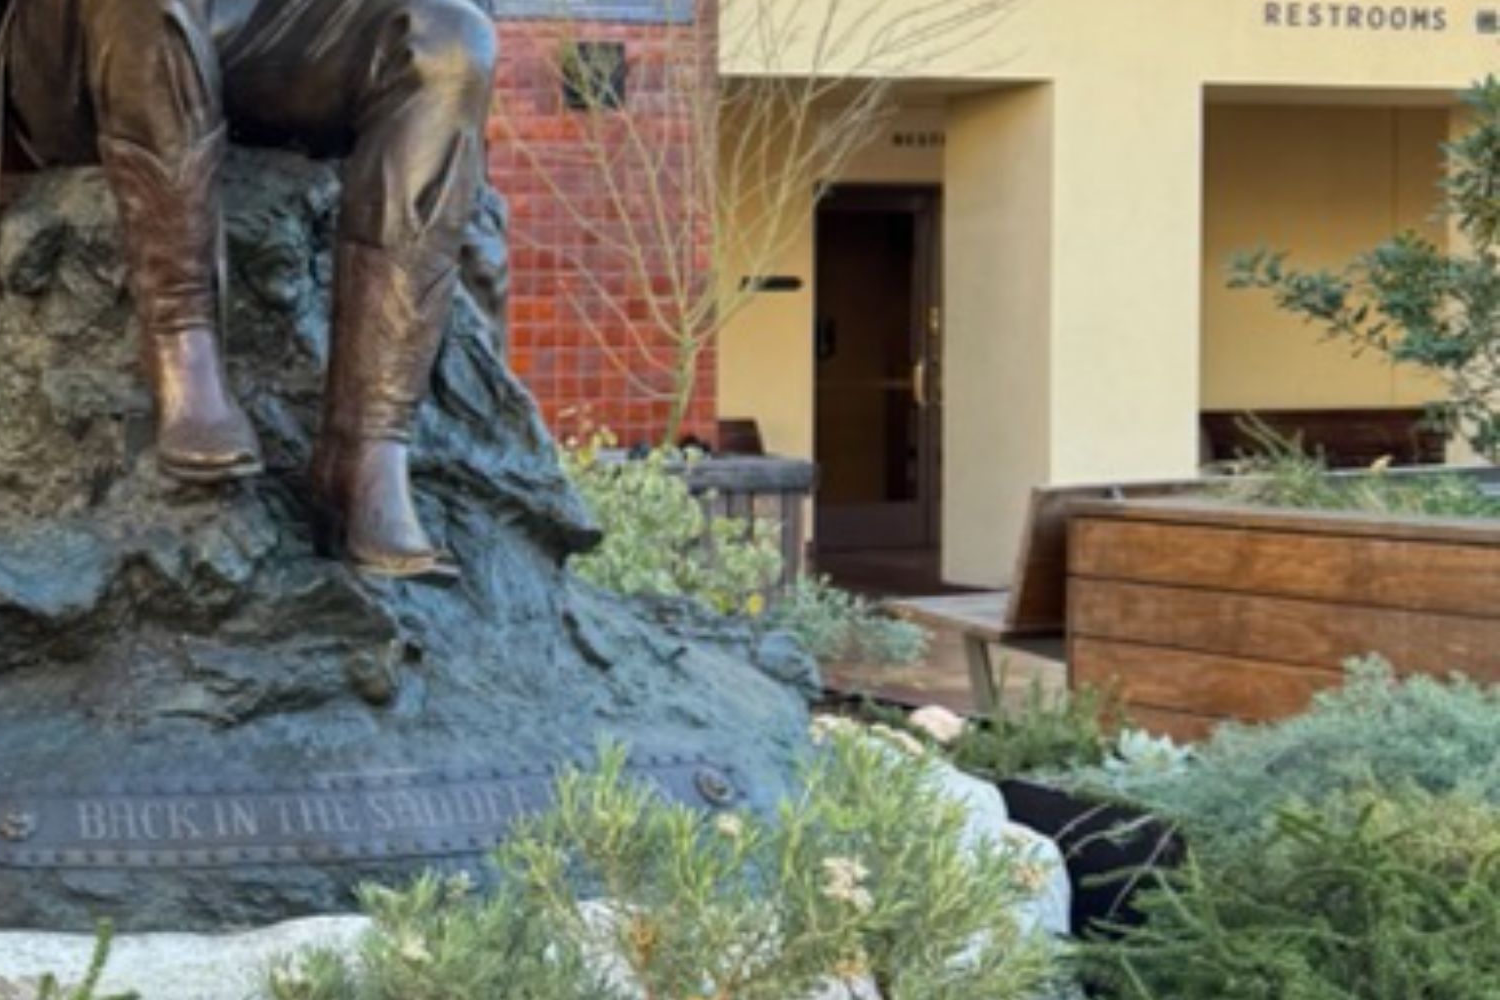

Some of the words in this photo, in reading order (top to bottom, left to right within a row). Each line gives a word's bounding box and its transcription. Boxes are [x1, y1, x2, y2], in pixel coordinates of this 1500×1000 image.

[1262, 1, 1448, 32] RESTROOMS
[77, 801, 202, 841] BACK
[212, 798, 260, 838] IN
[267, 795, 360, 835] THE
